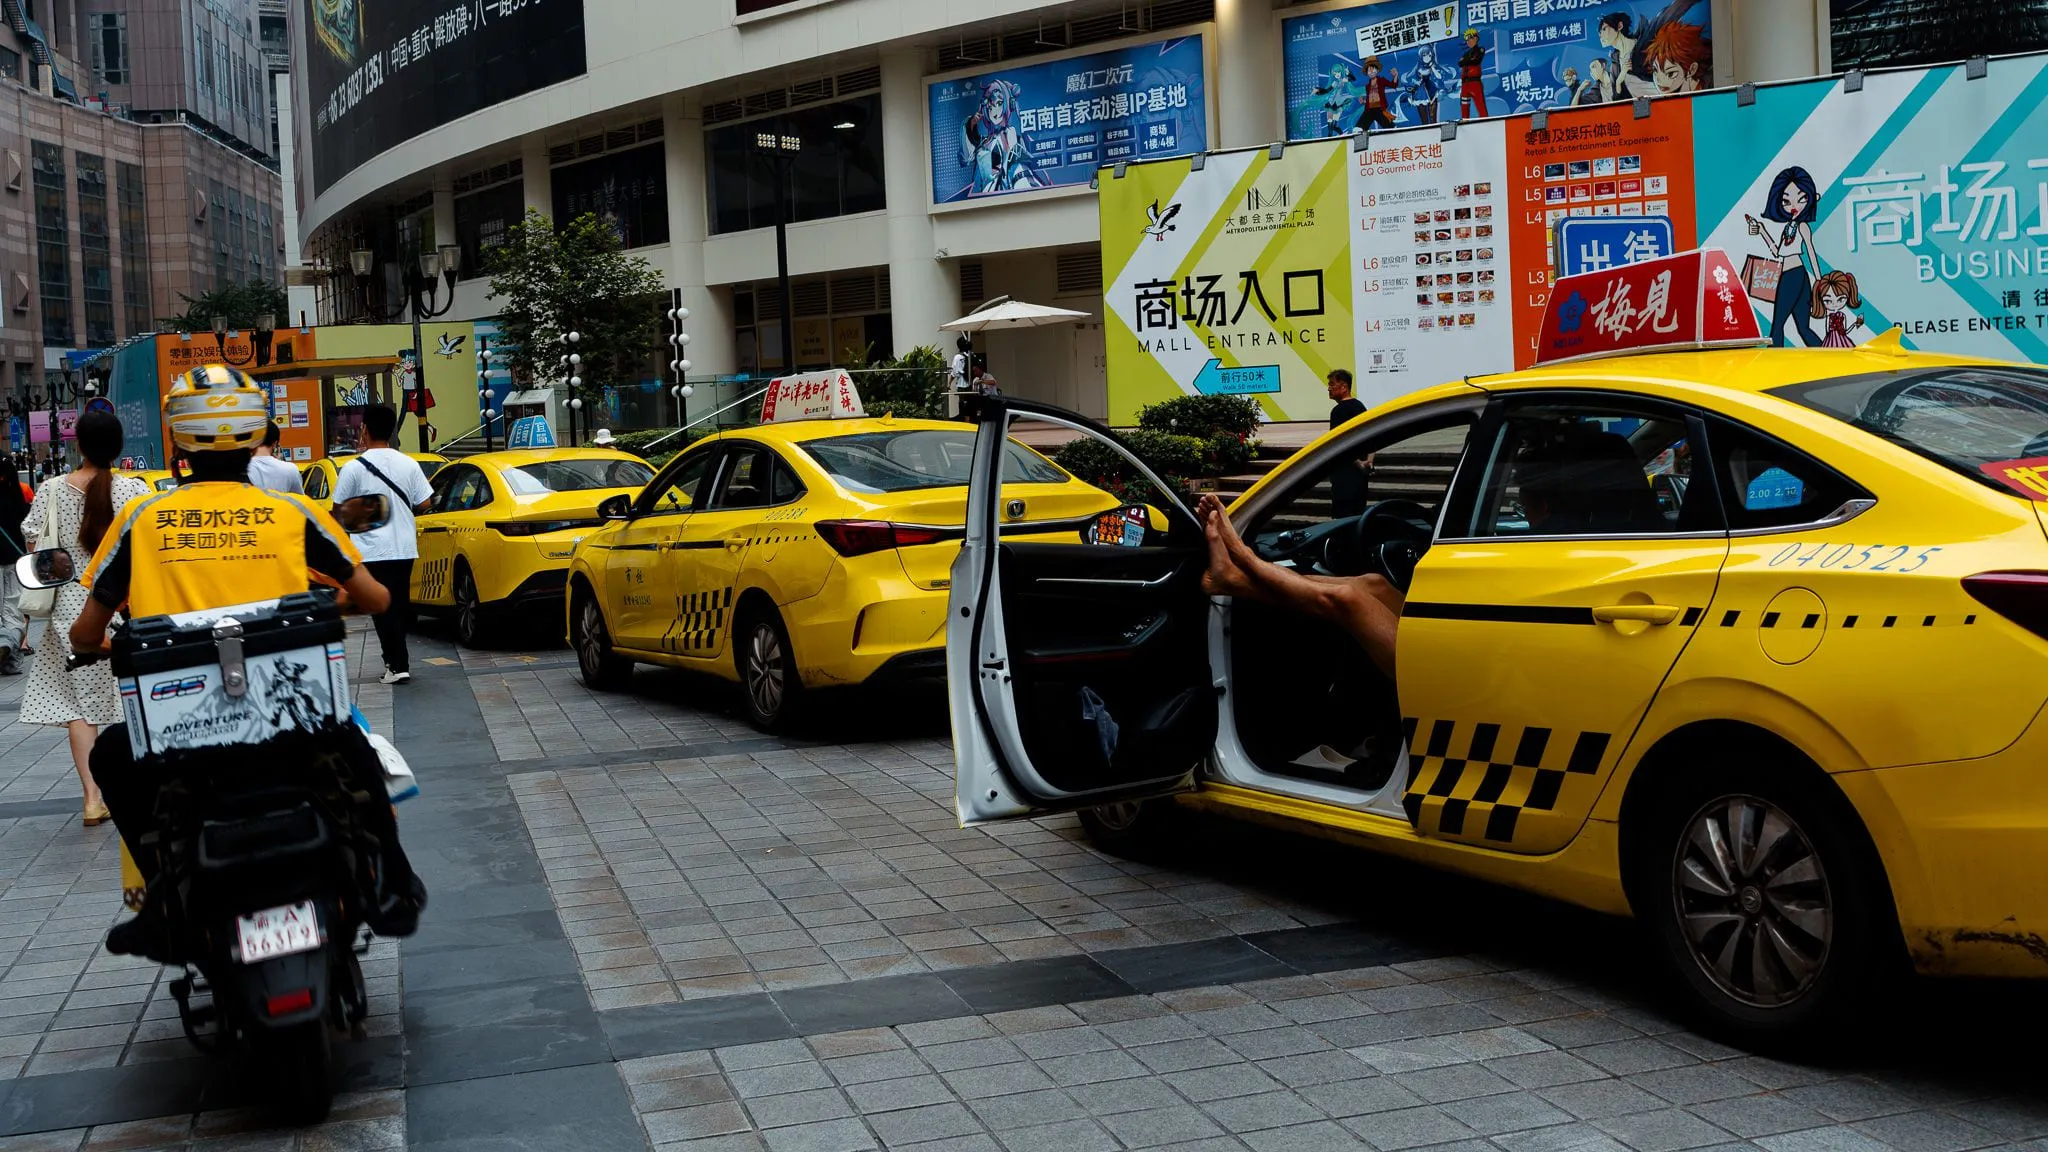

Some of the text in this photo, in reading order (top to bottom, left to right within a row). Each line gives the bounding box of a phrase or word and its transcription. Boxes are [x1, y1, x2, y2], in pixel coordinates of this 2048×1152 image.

[1360, 9, 1440, 41] 二次元动漫基地
[1513, 22, 1582, 45] 商场1楼/4楼
[1373, 25, 1431, 53] 空降重庆
[1501, 69, 1533, 93] 引爆
[1516, 86, 1554, 103] 次元力
[1019, 83, 1187, 134] 西南首家动漫IP基地
[1525, 121, 1621, 145] 零售及娱乐体验
[1558, 141, 1616, 153] Entertainment
[1618, 134, 1670, 146] Experiences
[1359, 143, 1442, 167] 山城美食天地
[1377, 163, 1416, 175] Gourmet
[1418, 160, 1443, 170] Plaza
[1524, 166, 1541, 179] L6
[1361, 194, 1376, 207] L8
[1525, 188, 1542, 202] L5
[1226, 208, 1315, 227] 大都会东方广场
[1362, 217, 1377, 231] L7
[1526, 211, 1543, 225] L4
[1226, 220, 1315, 235] METROPOLITAN ORIENTAL PLAZA
[1363, 257, 1379, 270] L6
[1364, 280, 1380, 292] L5
[1528, 271, 1545, 284] L3
[1134, 269, 1325, 332] 商场入口
[1529, 294, 1546, 307] L2
[1366, 320, 1381, 333] L4
[1969, 315, 2026, 331] ENTER
[1137, 328, 1326, 353] MALL ENTRANCE
[1221, 370, 1265, 384] 前行50米
[1749, 488, 1770, 499] 2.00
[156, 507, 275, 529] 买酒水冷饮
[158, 530, 257, 551] 上美团外卖
[1768, 542, 1943, 573] 040525
[163, 711, 253, 734] ADVENTURE
